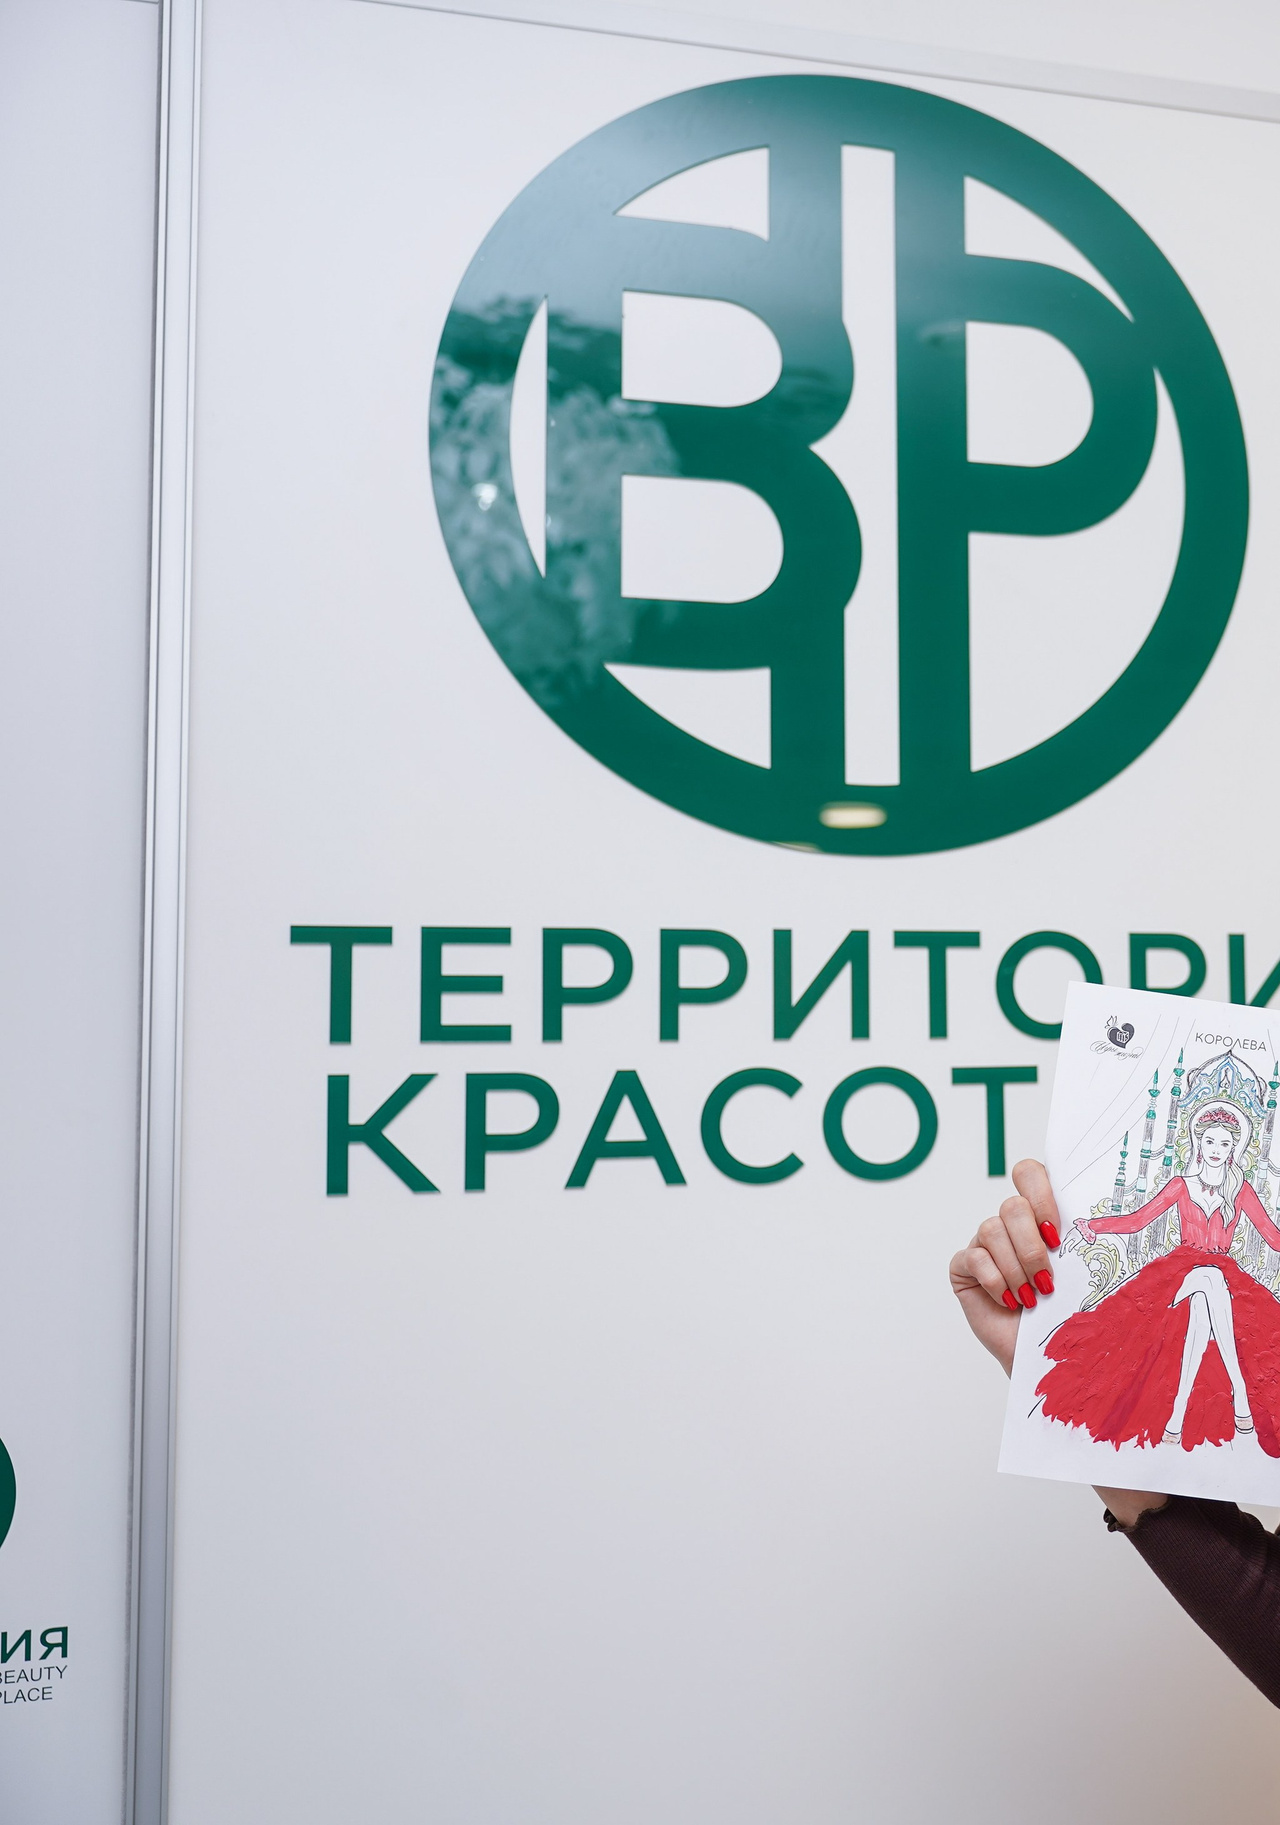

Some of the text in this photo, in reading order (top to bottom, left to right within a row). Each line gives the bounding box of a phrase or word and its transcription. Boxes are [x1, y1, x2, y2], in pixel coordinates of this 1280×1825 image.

[1195, 1032, 1267, 1052] КОРОЛЕВА
[0, 1664, 68, 1685] EAUTY
[0, 1686, 53, 1704] LACE
